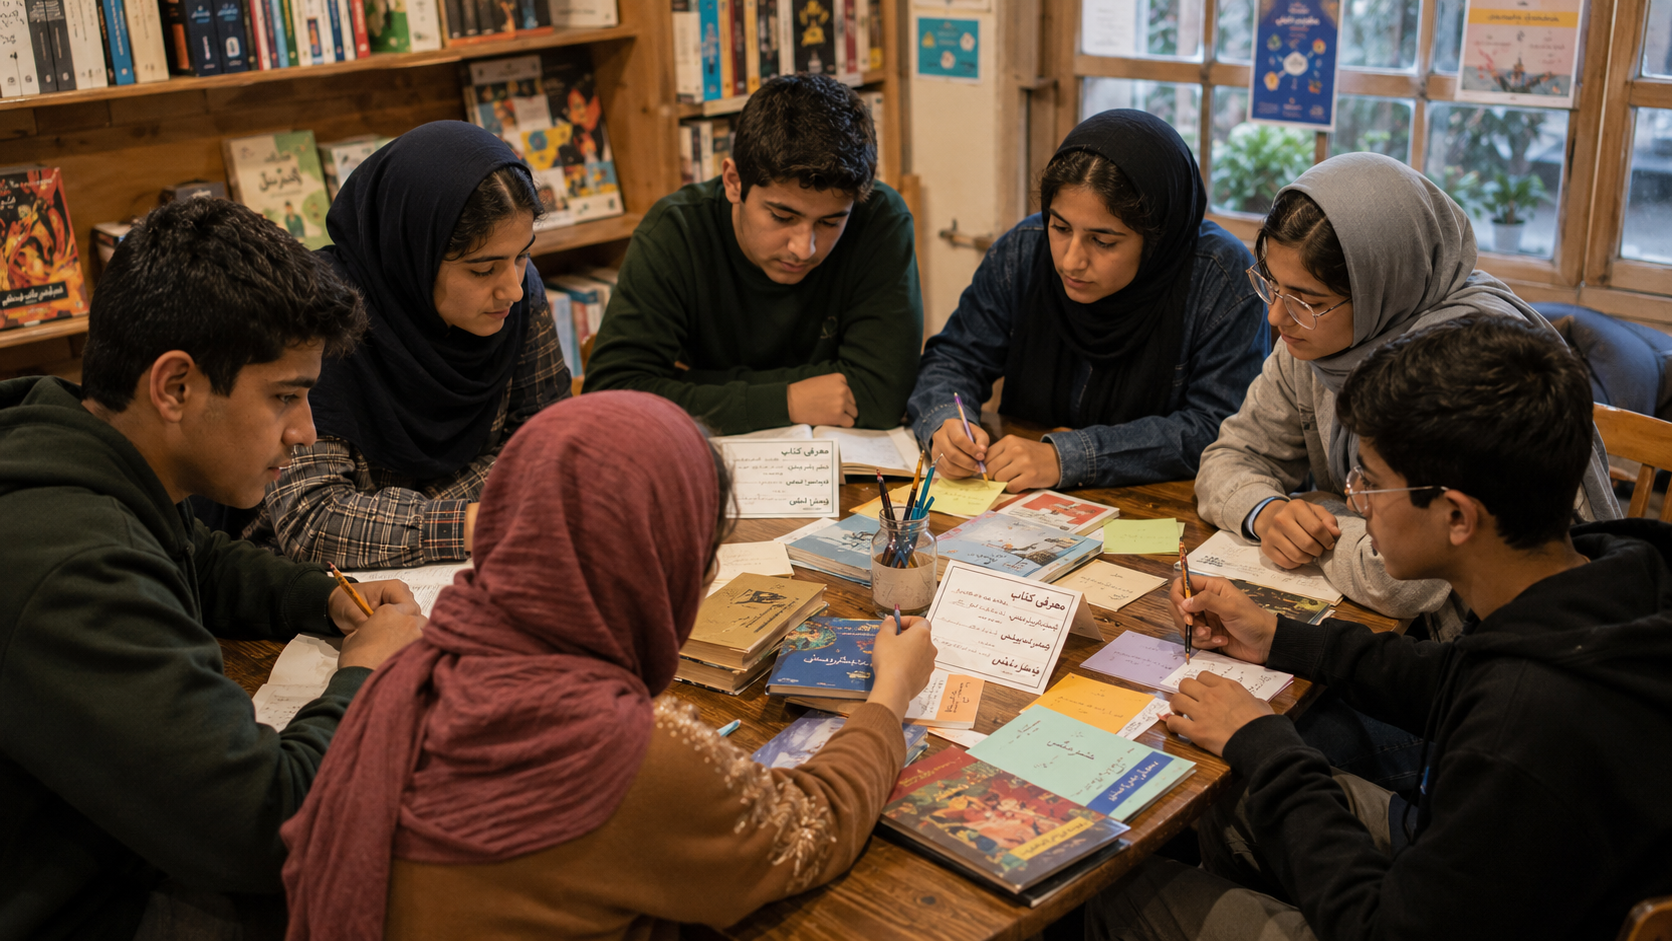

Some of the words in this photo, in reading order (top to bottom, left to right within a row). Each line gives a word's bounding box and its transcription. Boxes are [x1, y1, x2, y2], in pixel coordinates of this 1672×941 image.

[781, 447, 802, 456] کتاب
[803, 447, 829, 457] معرفی
[1010, 591, 1036, 602] کتاب
[1035, 596, 1066, 611] معرفی
